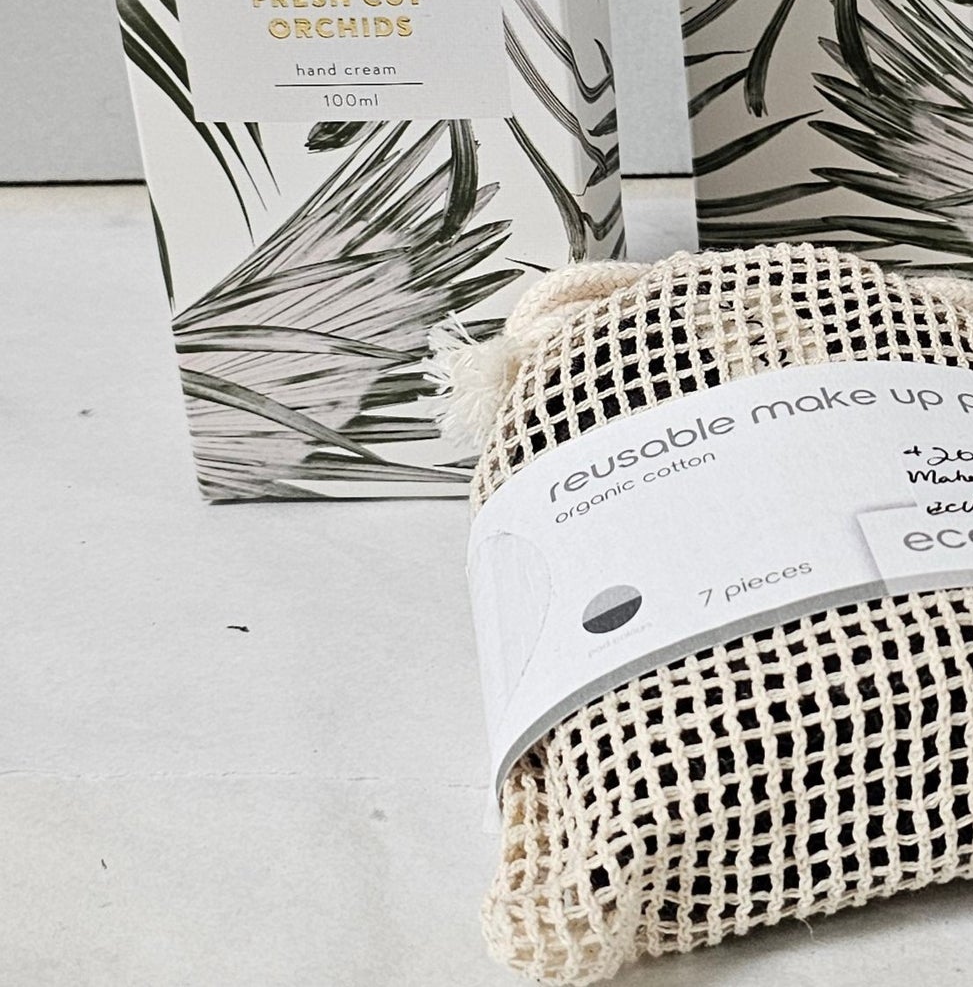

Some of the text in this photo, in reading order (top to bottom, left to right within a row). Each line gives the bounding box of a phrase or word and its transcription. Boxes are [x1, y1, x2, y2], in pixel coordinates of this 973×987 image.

[267, 16, 414, 40] ORCHIDS
[296, 63, 397, 77] hand cream
[323, 93, 380, 108] 100ml
[549, 416, 735, 502] reusable
[750, 387, 877, 424] make
[890, 388, 944, 411] up
[555, 452, 716, 524] organic cotton
[698, 562, 813, 607] 7 pieces
